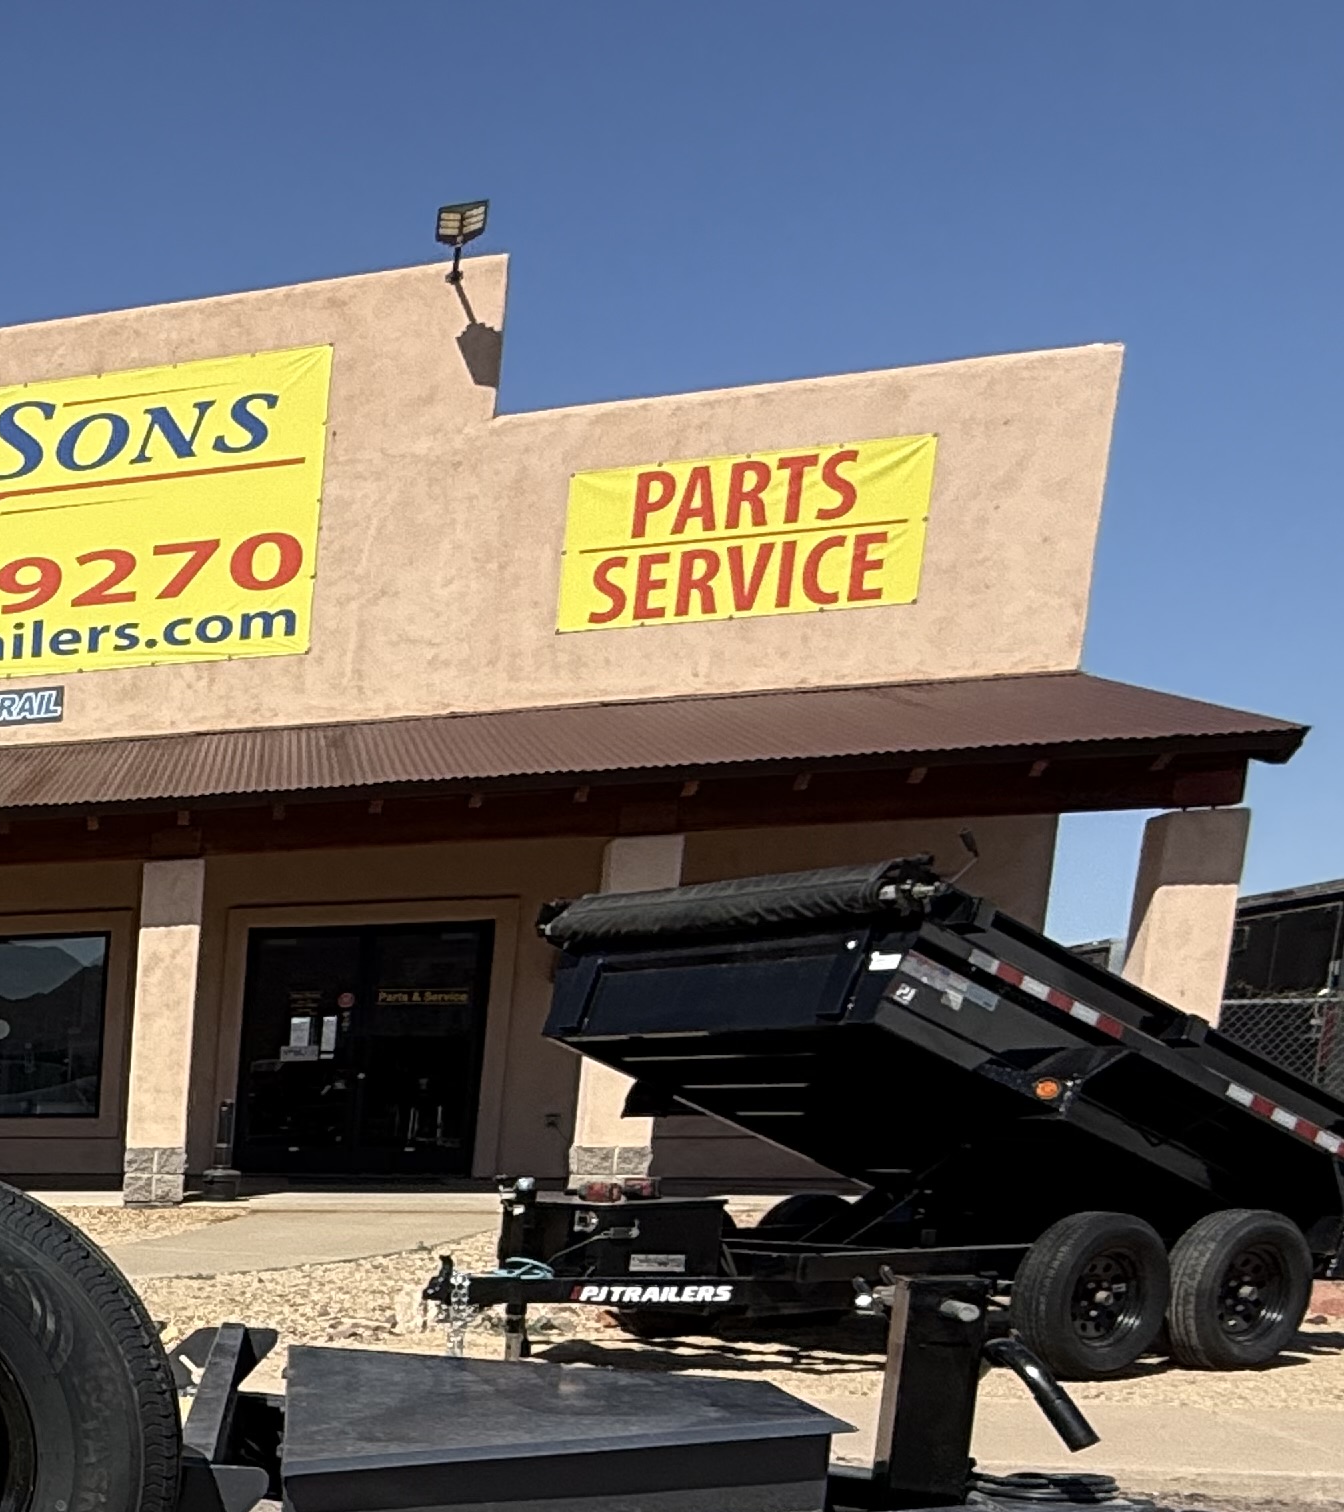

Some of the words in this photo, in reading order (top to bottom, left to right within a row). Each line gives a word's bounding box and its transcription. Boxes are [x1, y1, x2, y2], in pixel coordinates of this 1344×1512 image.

[631, 449, 859, 539] PARTS
[588, 531, 888, 624] SERVICE
[378, 992, 408, 1003] Parts
[412, 993, 421, 1002] &
[424, 992, 469, 1003] Service
[609, 1286, 733, 1302] TRAILERS
